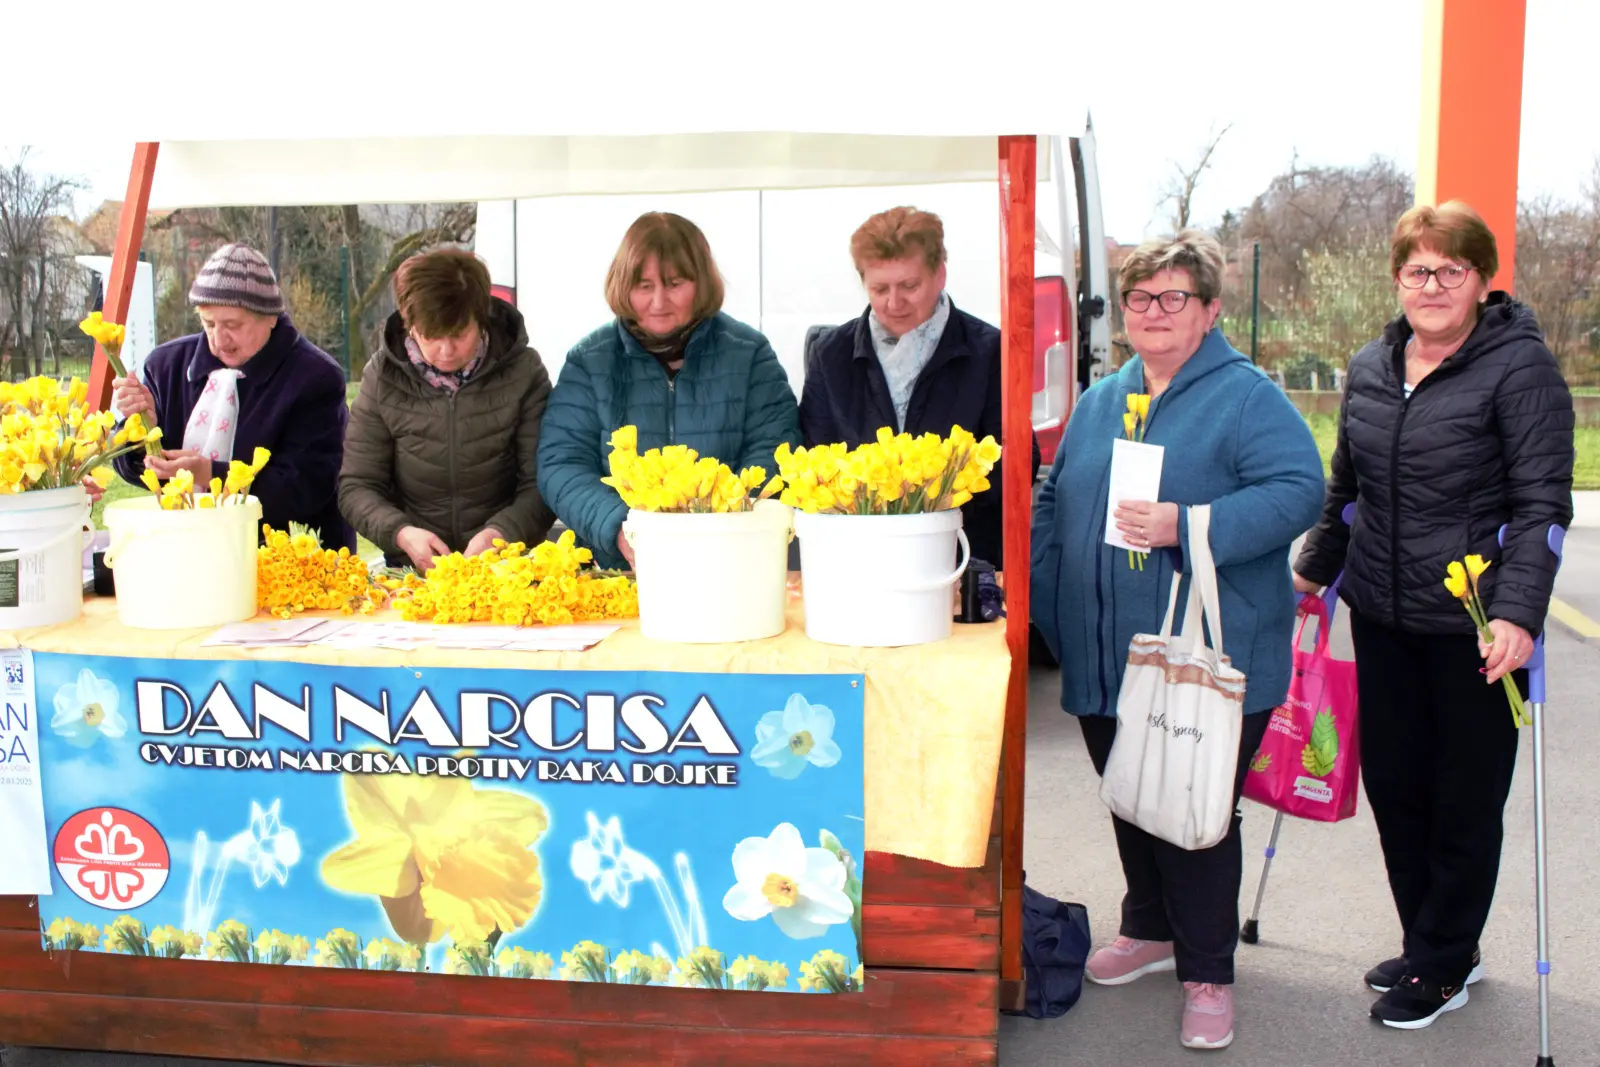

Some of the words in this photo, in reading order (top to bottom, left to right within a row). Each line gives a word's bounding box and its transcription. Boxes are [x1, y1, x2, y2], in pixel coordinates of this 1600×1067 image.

[136, 680, 310, 742] DAN
[335, 685, 740, 754] NARCISA
[140, 743, 274, 770] CVJETOM
[280, 750, 412, 774] NARCISA
[417, 756, 532, 780] PROTIV
[538, 760, 626, 783] RAKA
[633, 763, 737, 785] DOJKE
